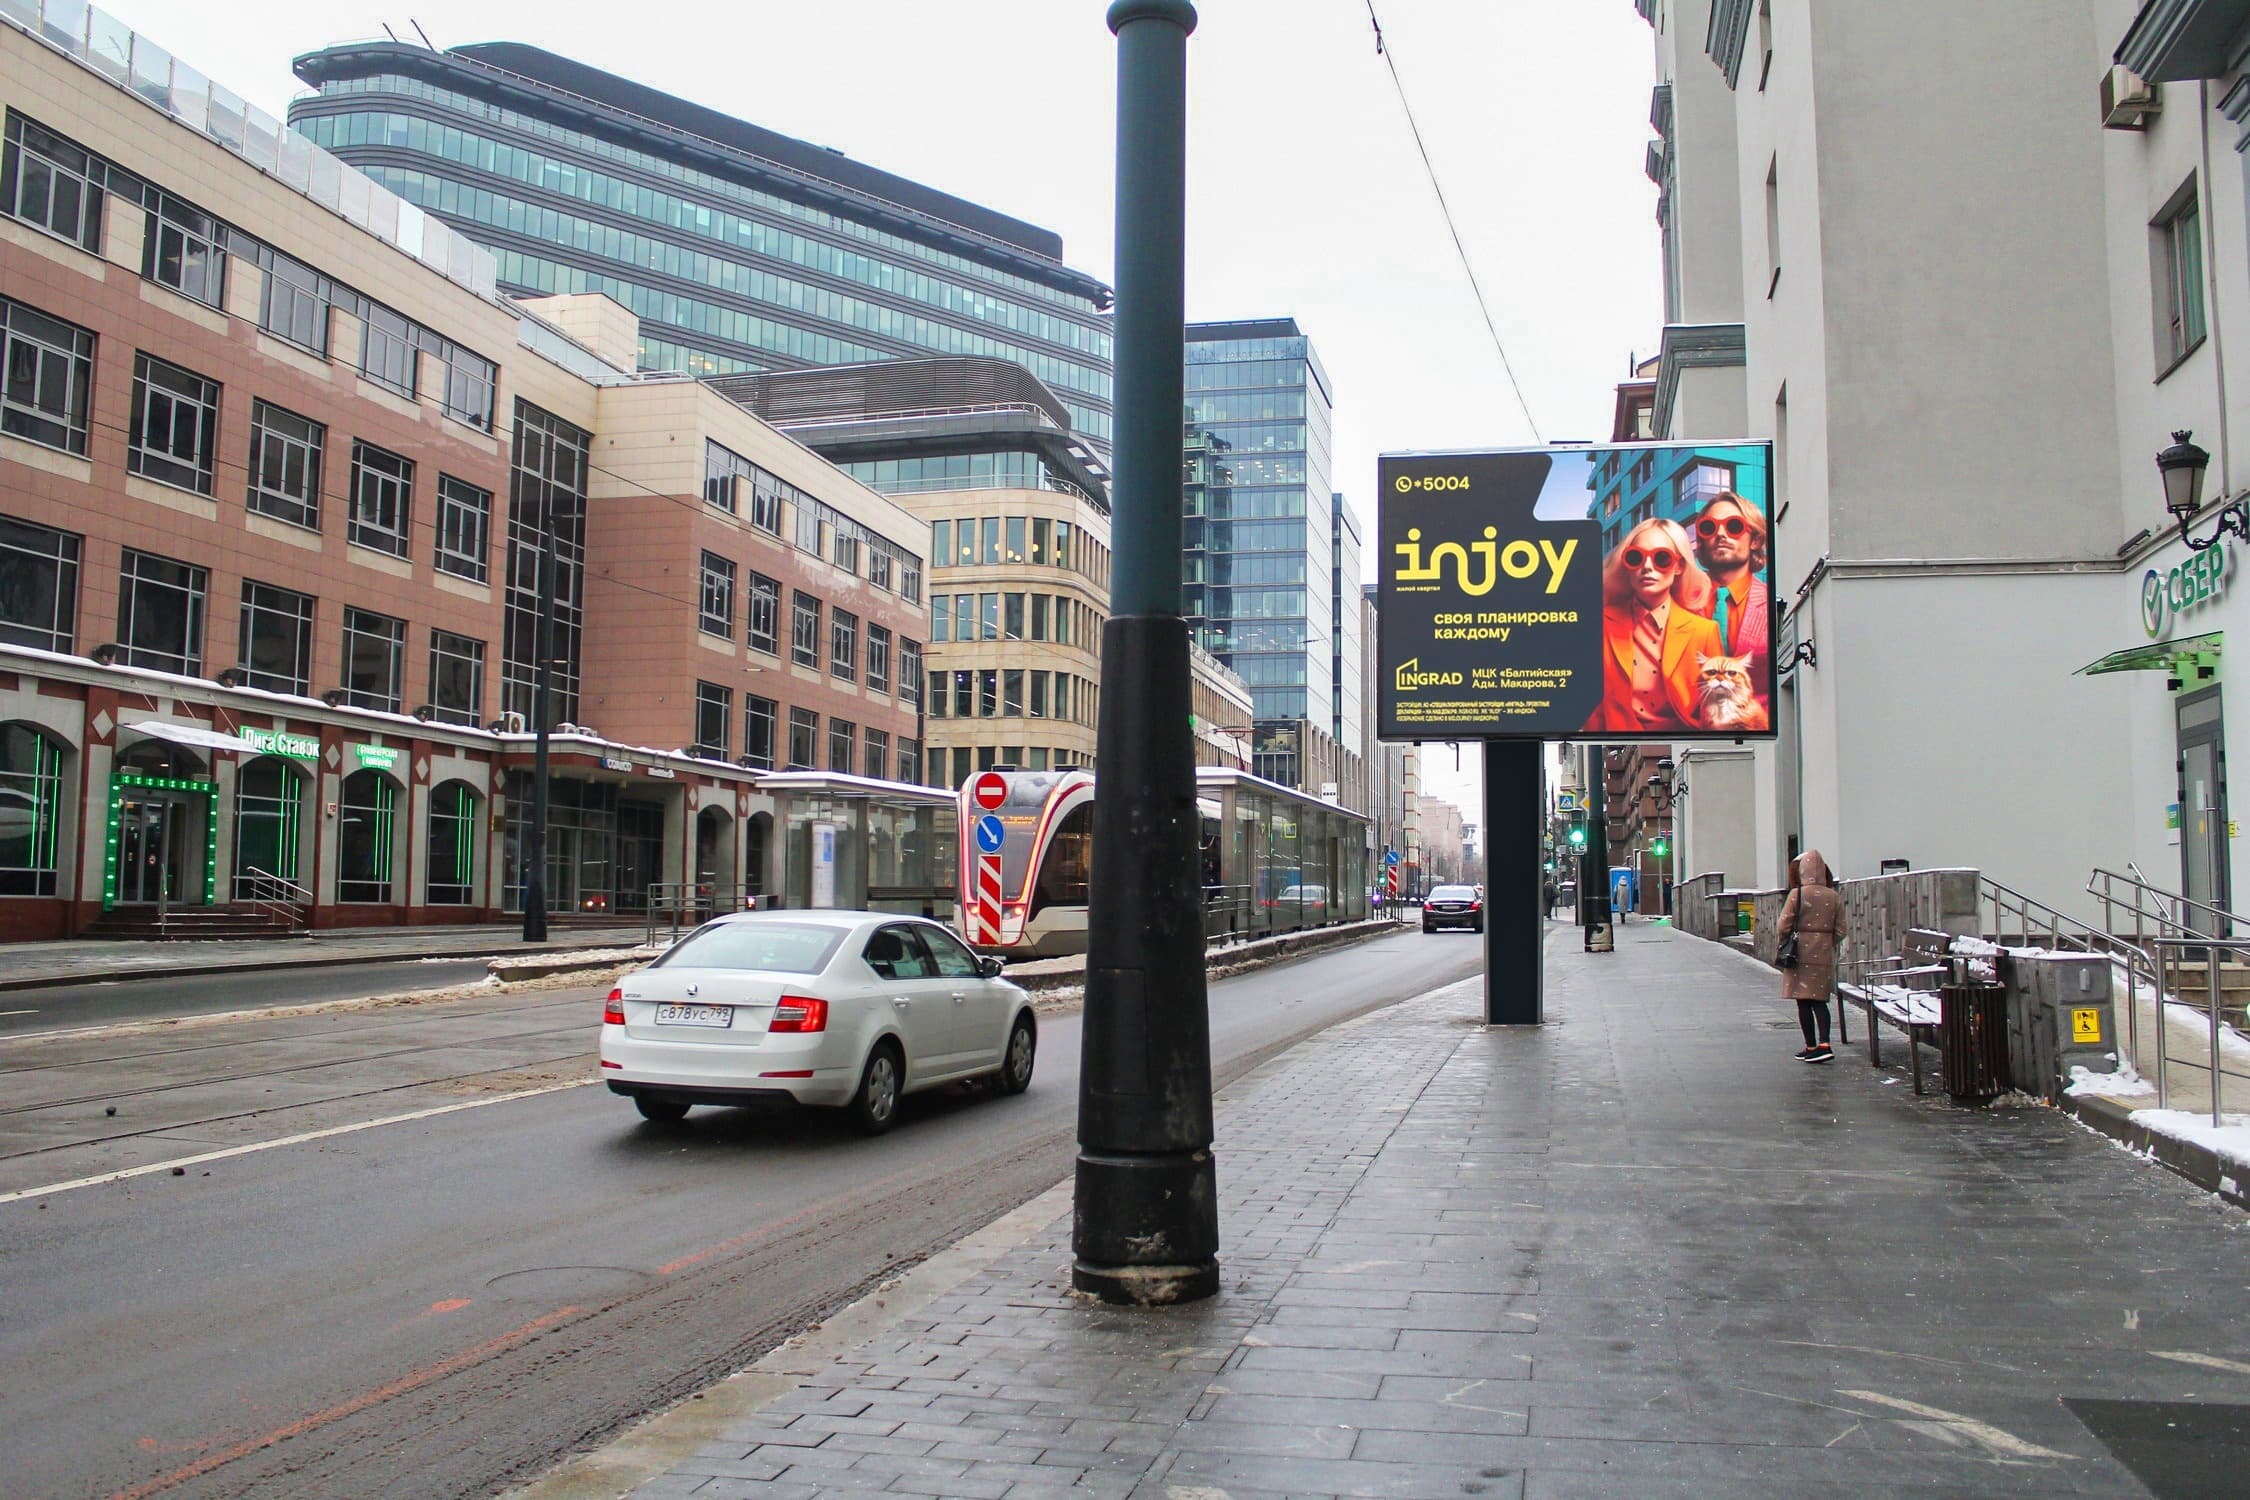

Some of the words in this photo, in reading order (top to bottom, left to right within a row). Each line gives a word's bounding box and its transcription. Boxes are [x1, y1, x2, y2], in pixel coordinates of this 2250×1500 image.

[1396, 526, 1579, 596] injoy
[2168, 543, 2225, 613] СБЕР
[1434, 612, 1473, 625] своя
[1477, 610, 1579, 627] планировка
[1434, 627, 1511, 642] каждому
[1400, 672, 1464, 686] INGRAD
[1472, 668, 1497, 678] МЦК
[1499, 667, 1573, 679] «Балтийская»
[1472, 680, 1498, 689] Адм.
[1500, 679, 1557, 690] Макарова,
[1559, 678, 1567, 688] 2
[277, 733, 321, 758] Ставок
